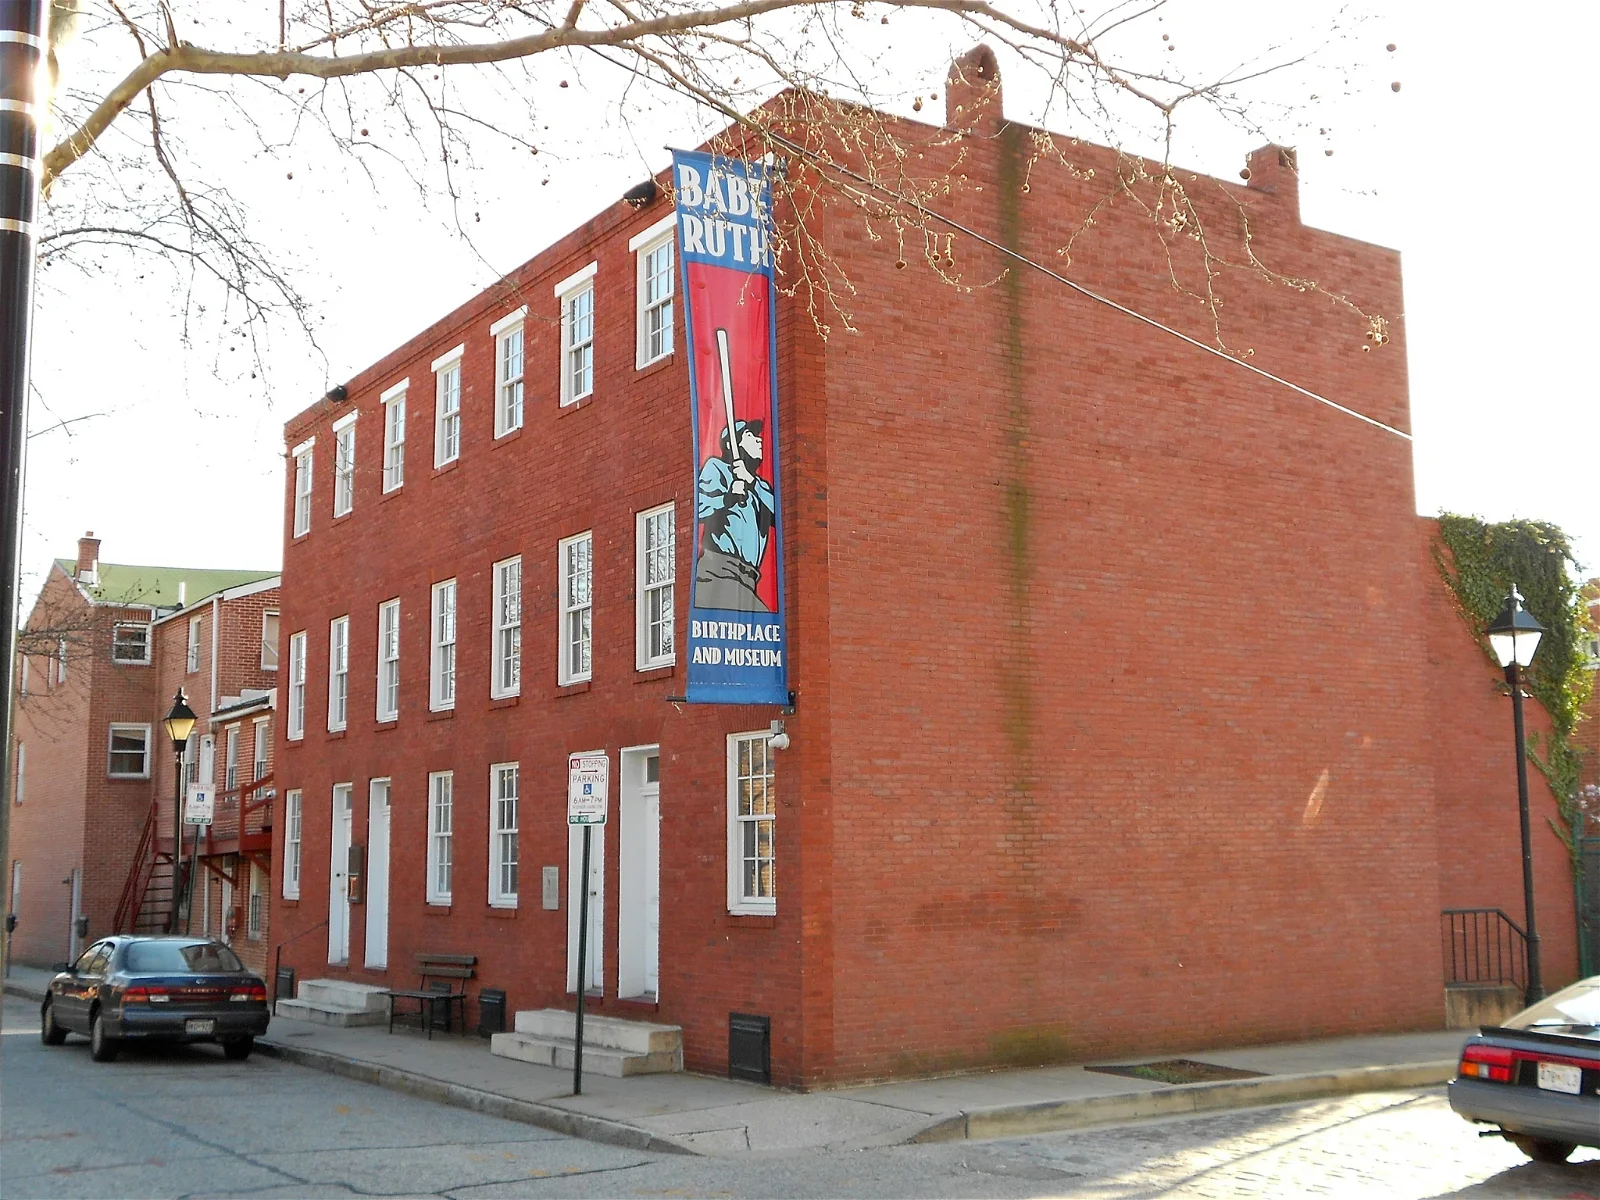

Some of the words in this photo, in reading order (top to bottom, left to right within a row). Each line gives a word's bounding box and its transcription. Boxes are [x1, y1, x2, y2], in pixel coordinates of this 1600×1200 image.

[677, 164, 769, 221] BABE
[682, 213, 770, 268] RUTH
[692, 620, 781, 642] BIRTHPLACE
[692, 646, 721, 665] AND
[724, 648, 782, 667] MUSEUM
[571, 760, 580, 769] NO
[582, 760, 606, 768] STOPPING
[573, 774, 605, 783] PARKING
